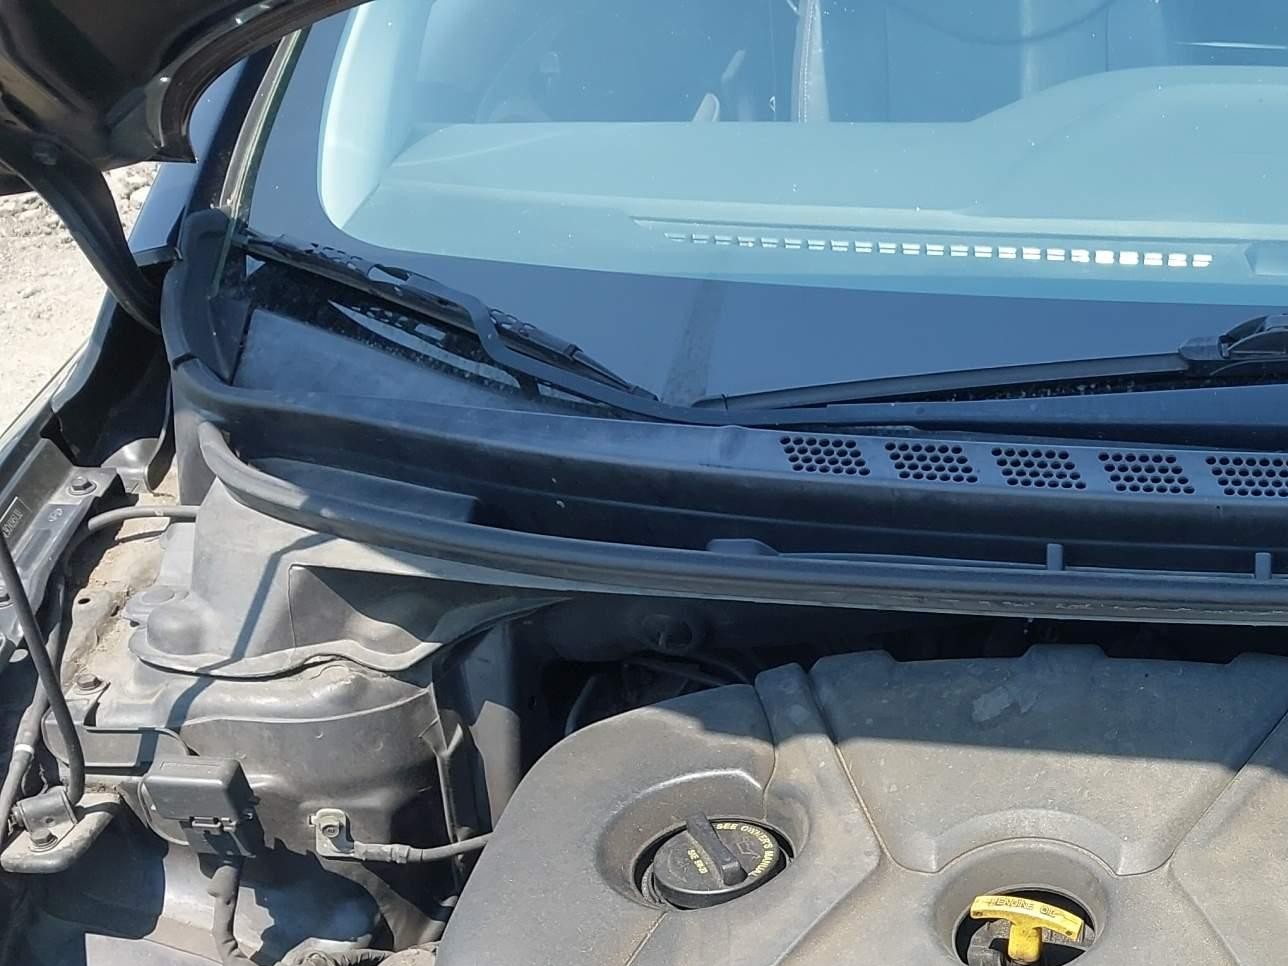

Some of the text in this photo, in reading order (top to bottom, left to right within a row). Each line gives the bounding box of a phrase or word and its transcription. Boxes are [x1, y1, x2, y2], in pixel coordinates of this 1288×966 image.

[716, 822, 739, 831] SEE
[996, 898, 1056, 918] ENGINE OIL
